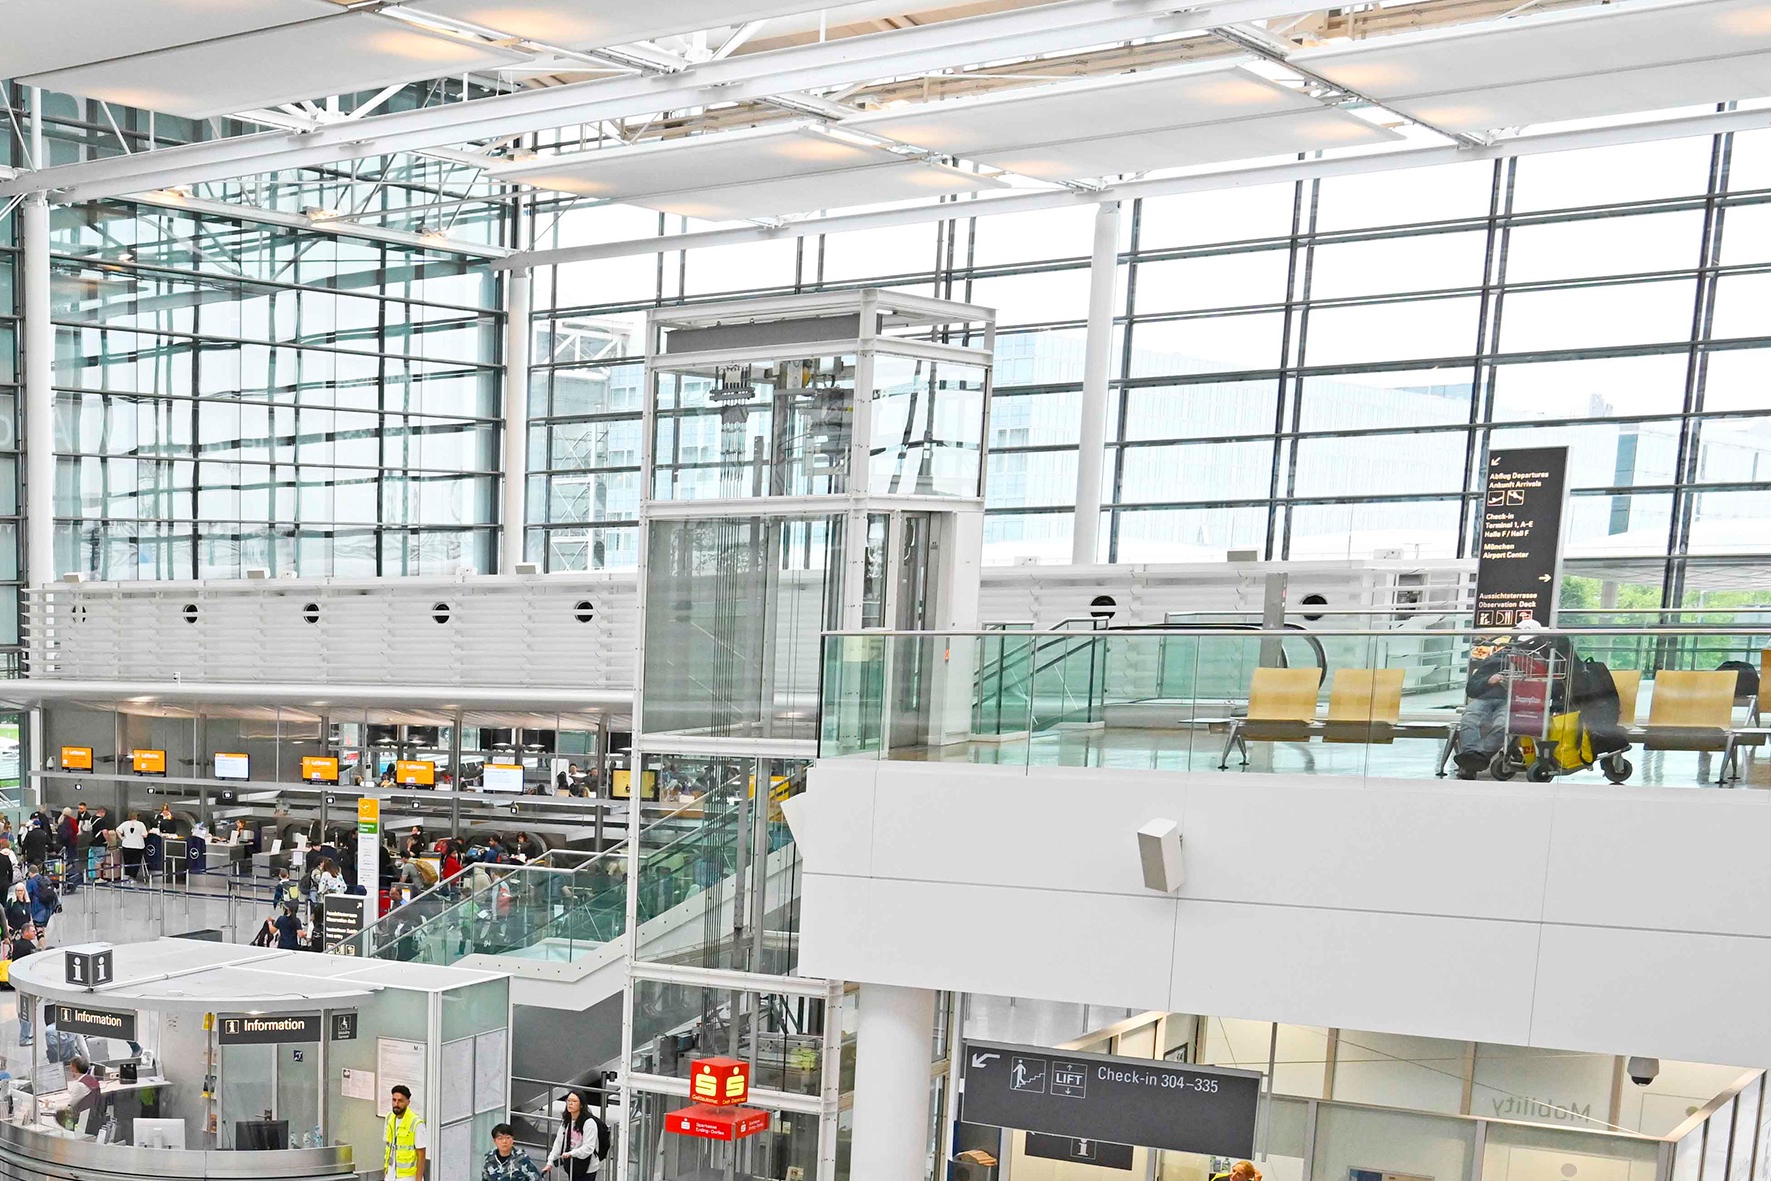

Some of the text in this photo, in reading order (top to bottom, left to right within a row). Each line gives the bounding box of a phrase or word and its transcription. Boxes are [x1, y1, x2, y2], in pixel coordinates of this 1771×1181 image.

[1489, 471, 1549, 481] Abflug Departures
[1515, 480, 1542, 488] Arrivals
[1485, 521, 1513, 529] Terminal
[1484, 530, 1501, 538] Halle
[1484, 542, 1515, 550] München
[1482, 552, 1506, 560] Airport
[1479, 592, 1538, 600] Aussichtsterrasse
[1478, 600, 1536, 608] Observation Deck
[74, 1010, 122, 1028] Information
[244, 1018, 306, 1032] Information
[1056, 1073, 1083, 1086] LIFT
[1098, 1066, 1157, 1086] Check-in
